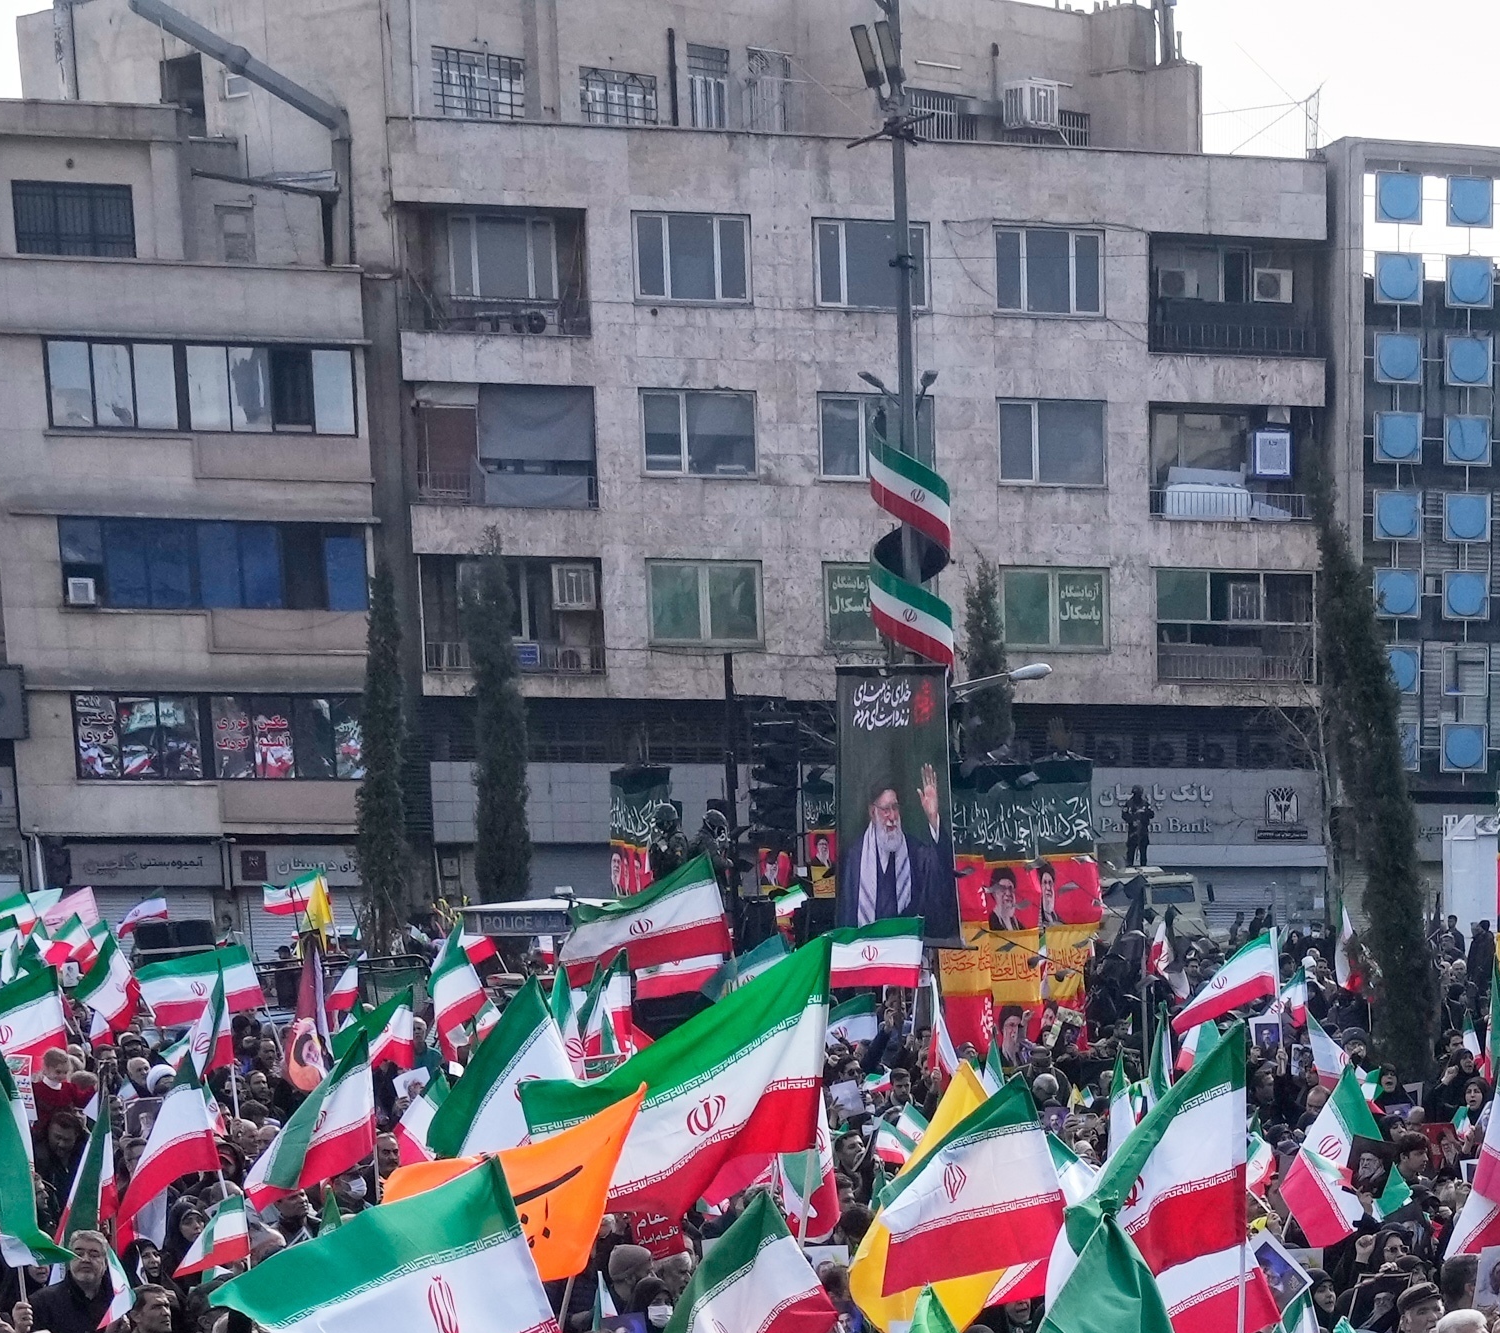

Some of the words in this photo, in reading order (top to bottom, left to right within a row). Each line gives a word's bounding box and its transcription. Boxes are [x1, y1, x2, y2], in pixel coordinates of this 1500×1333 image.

[1060, 583, 1099, 600] آزمایشگاه
[1060, 602, 1100, 625] پاسکال
[80, 712, 115, 727] عکس
[216, 712, 249, 731] فوری
[257, 714, 289, 731] عکس
[80, 727, 115, 744] فوری
[1171, 783, 1214, 808] بانک
[1169, 816, 1214, 833] Bank
[483, 915, 532, 930] POLICE
